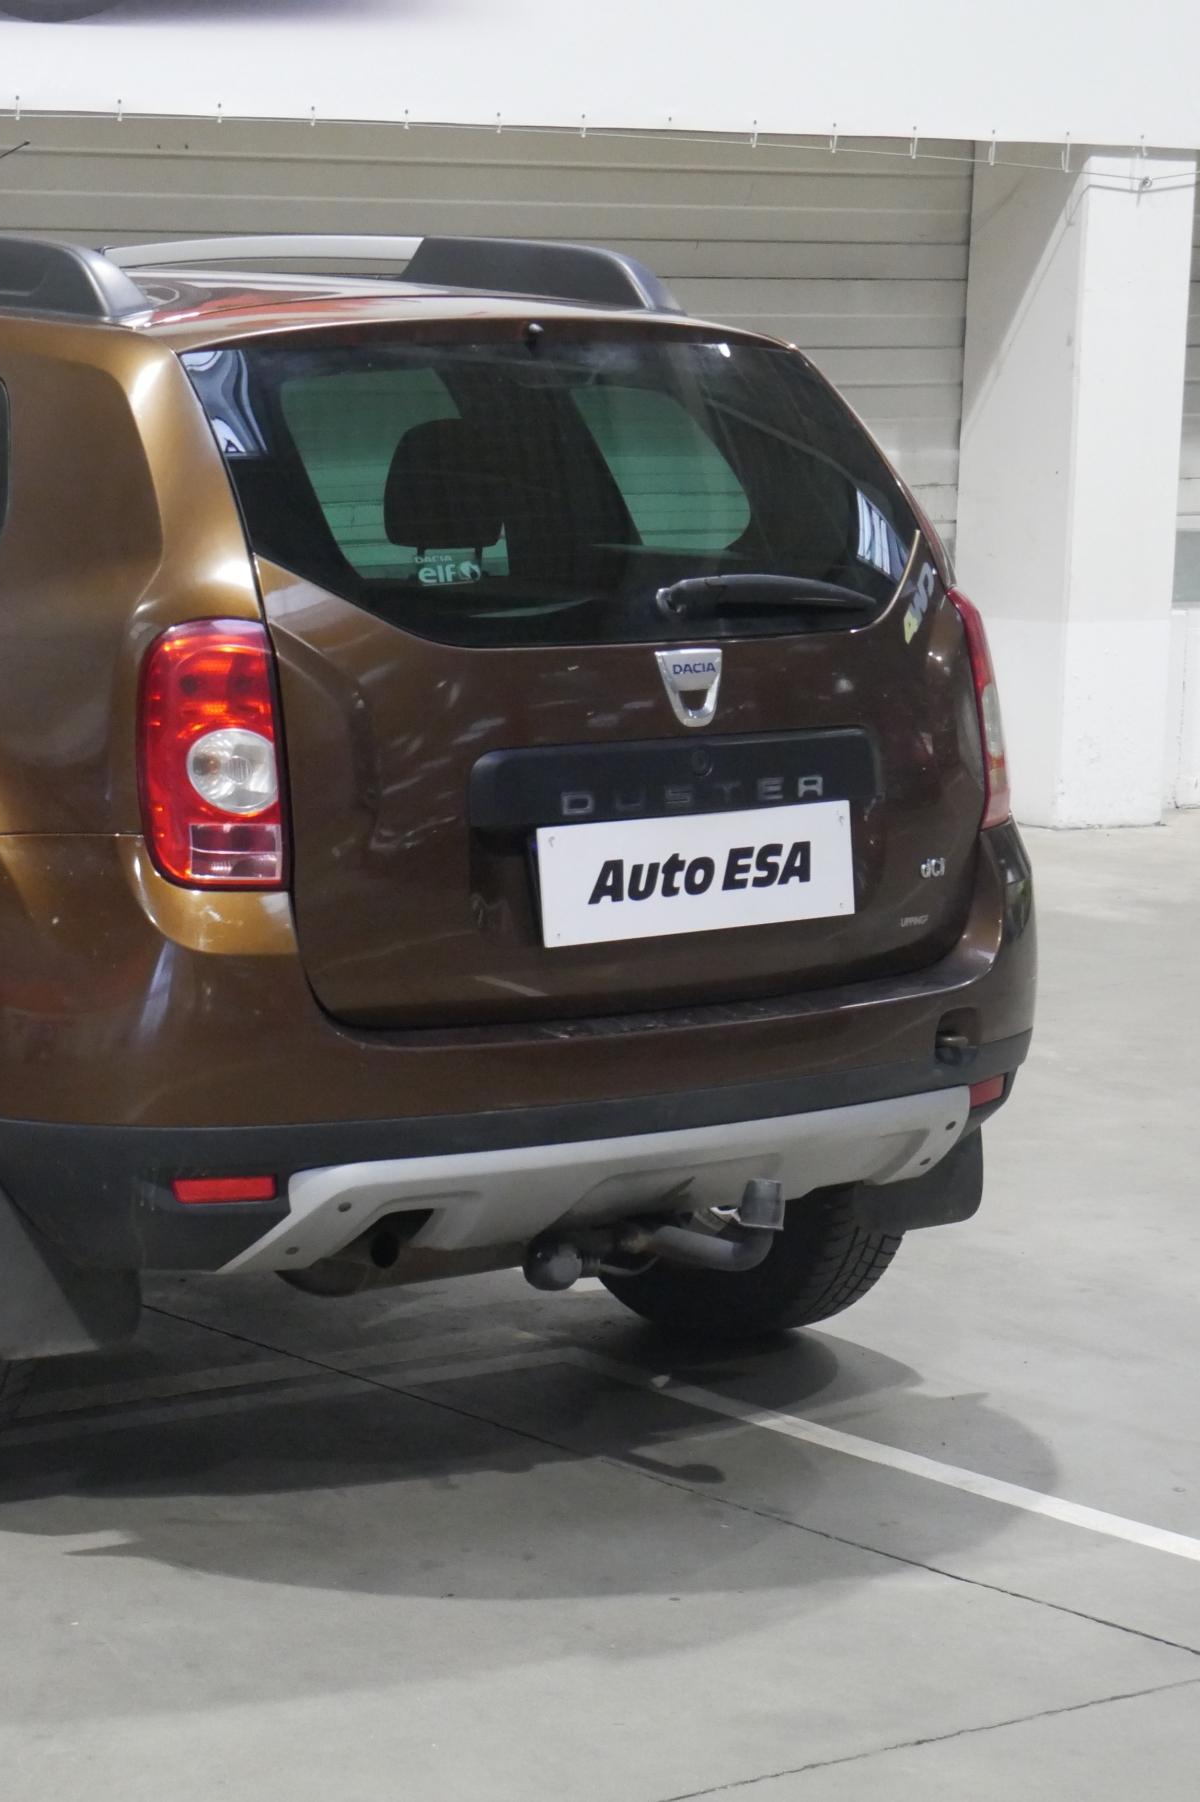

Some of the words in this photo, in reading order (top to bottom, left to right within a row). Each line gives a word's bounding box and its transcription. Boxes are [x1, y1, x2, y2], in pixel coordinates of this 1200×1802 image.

[418, 564, 456, 583] elf
[672, 662, 717, 675] DACIA
[560, 775, 824, 817] DUSTER
[588, 853, 715, 905] Auto
[722, 841, 811, 891] ESA
